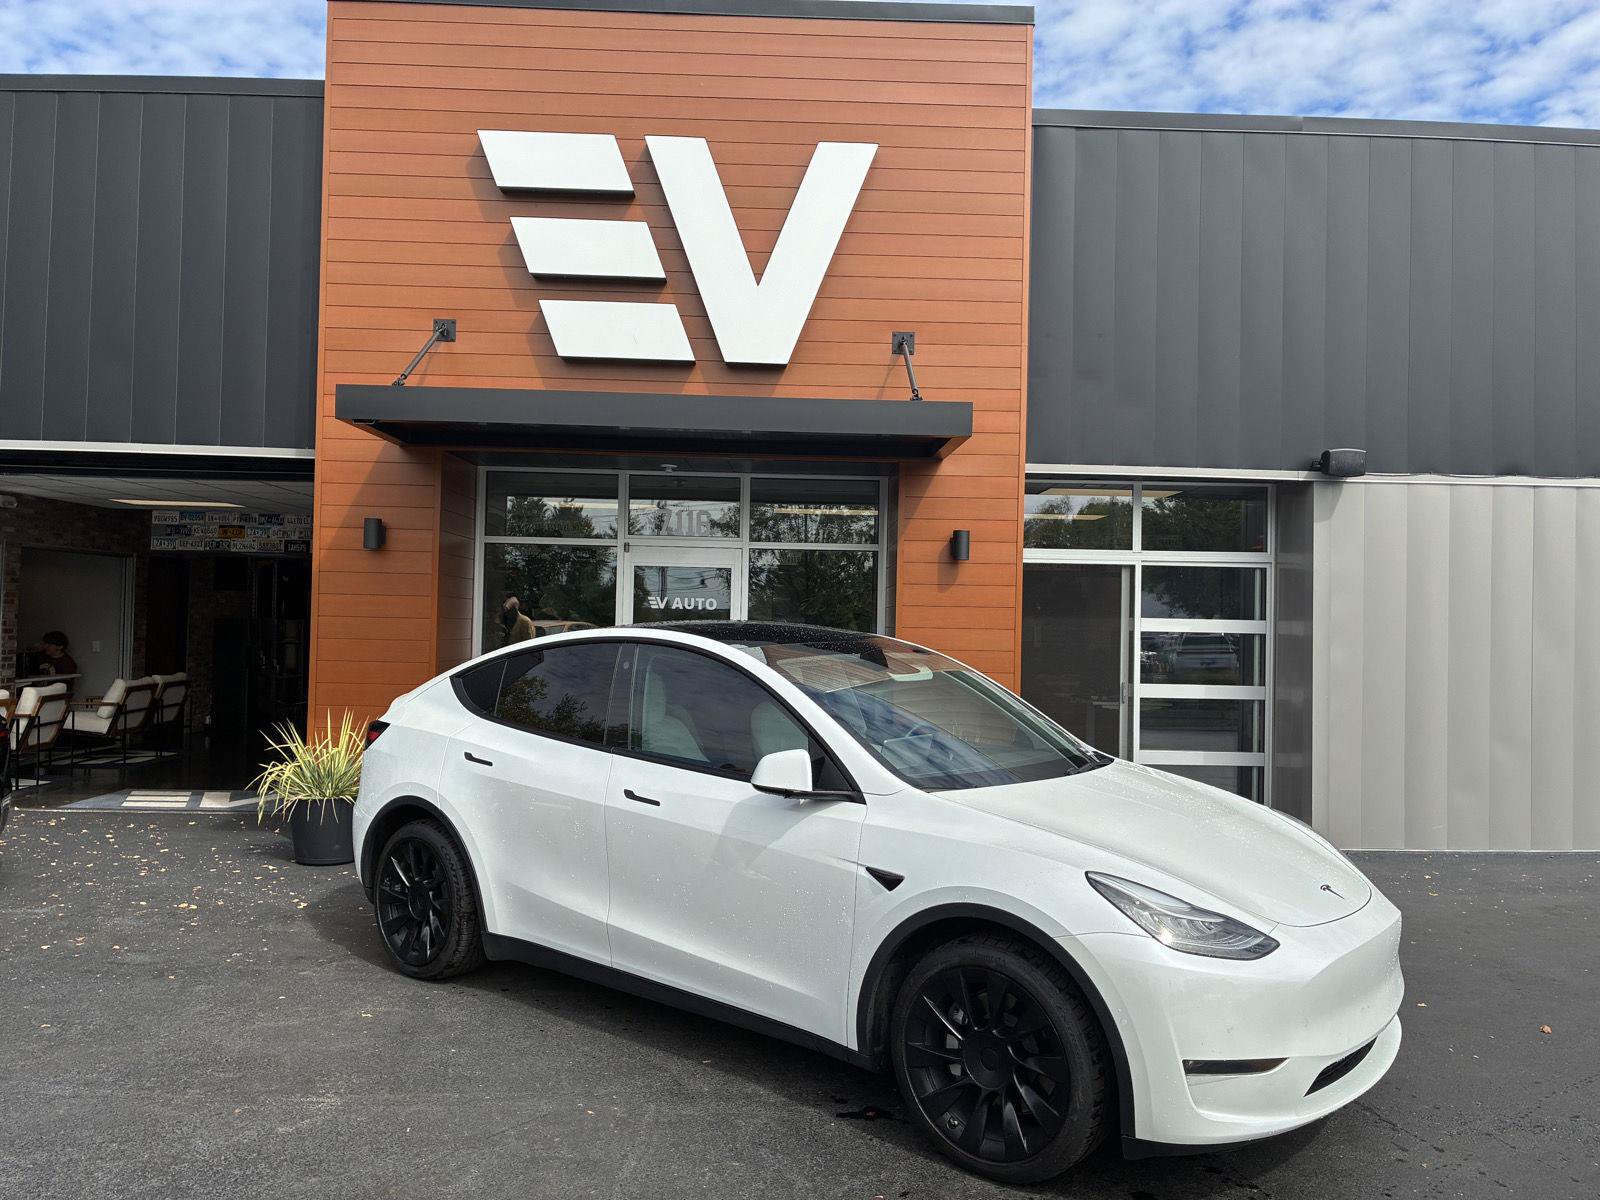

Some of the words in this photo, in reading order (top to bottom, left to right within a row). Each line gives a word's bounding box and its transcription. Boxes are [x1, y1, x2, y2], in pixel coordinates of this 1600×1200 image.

[477, 130, 878, 367] EV
[648, 596, 668, 609] EV
[671, 597, 717, 610] AUTO
